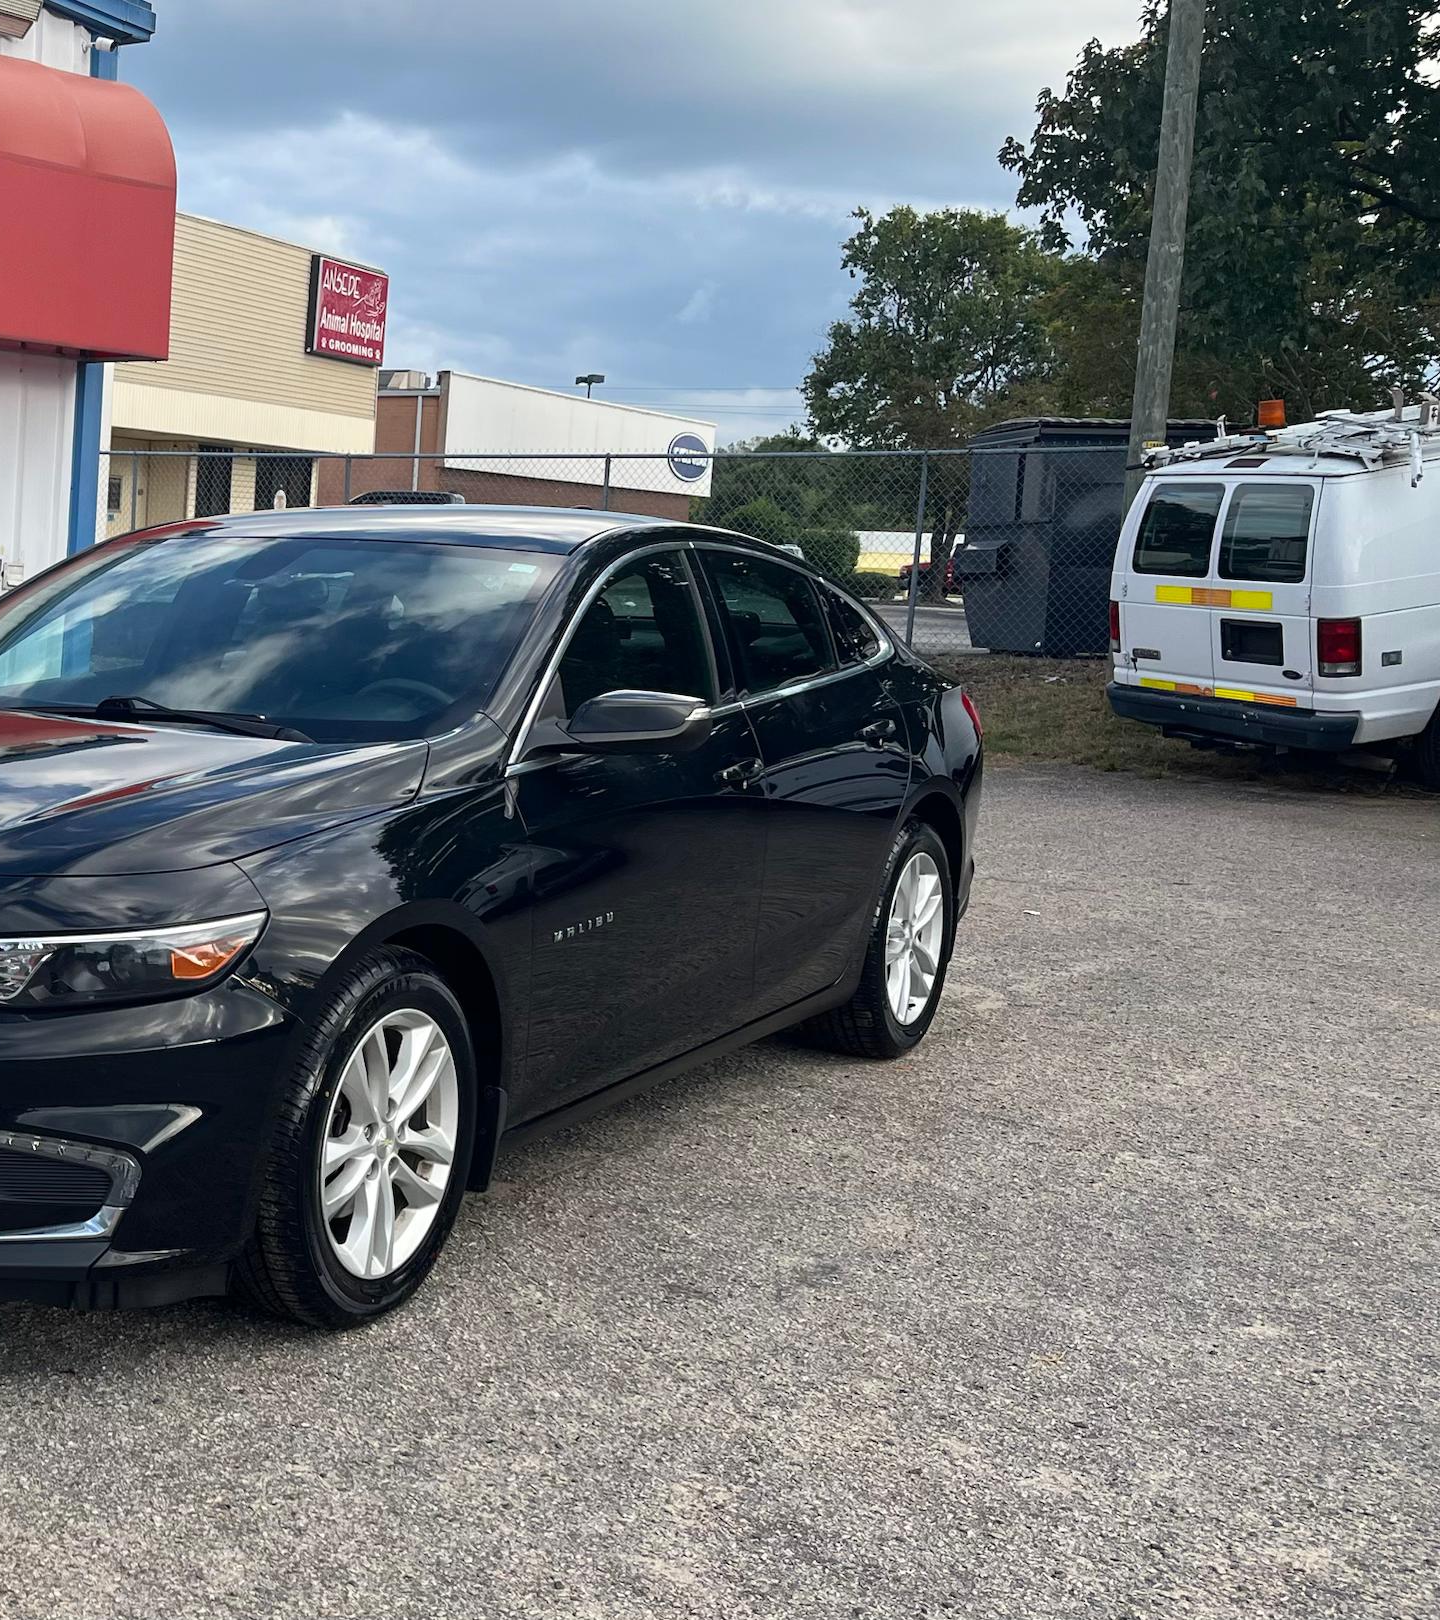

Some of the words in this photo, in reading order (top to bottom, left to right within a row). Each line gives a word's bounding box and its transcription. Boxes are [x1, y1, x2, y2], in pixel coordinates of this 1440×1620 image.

[319, 307, 348, 334] Animal
[350, 313, 385, 344] Hospital
[328, 338, 374, 358] GROOMING
[554, 911, 614, 943] MALIBU
